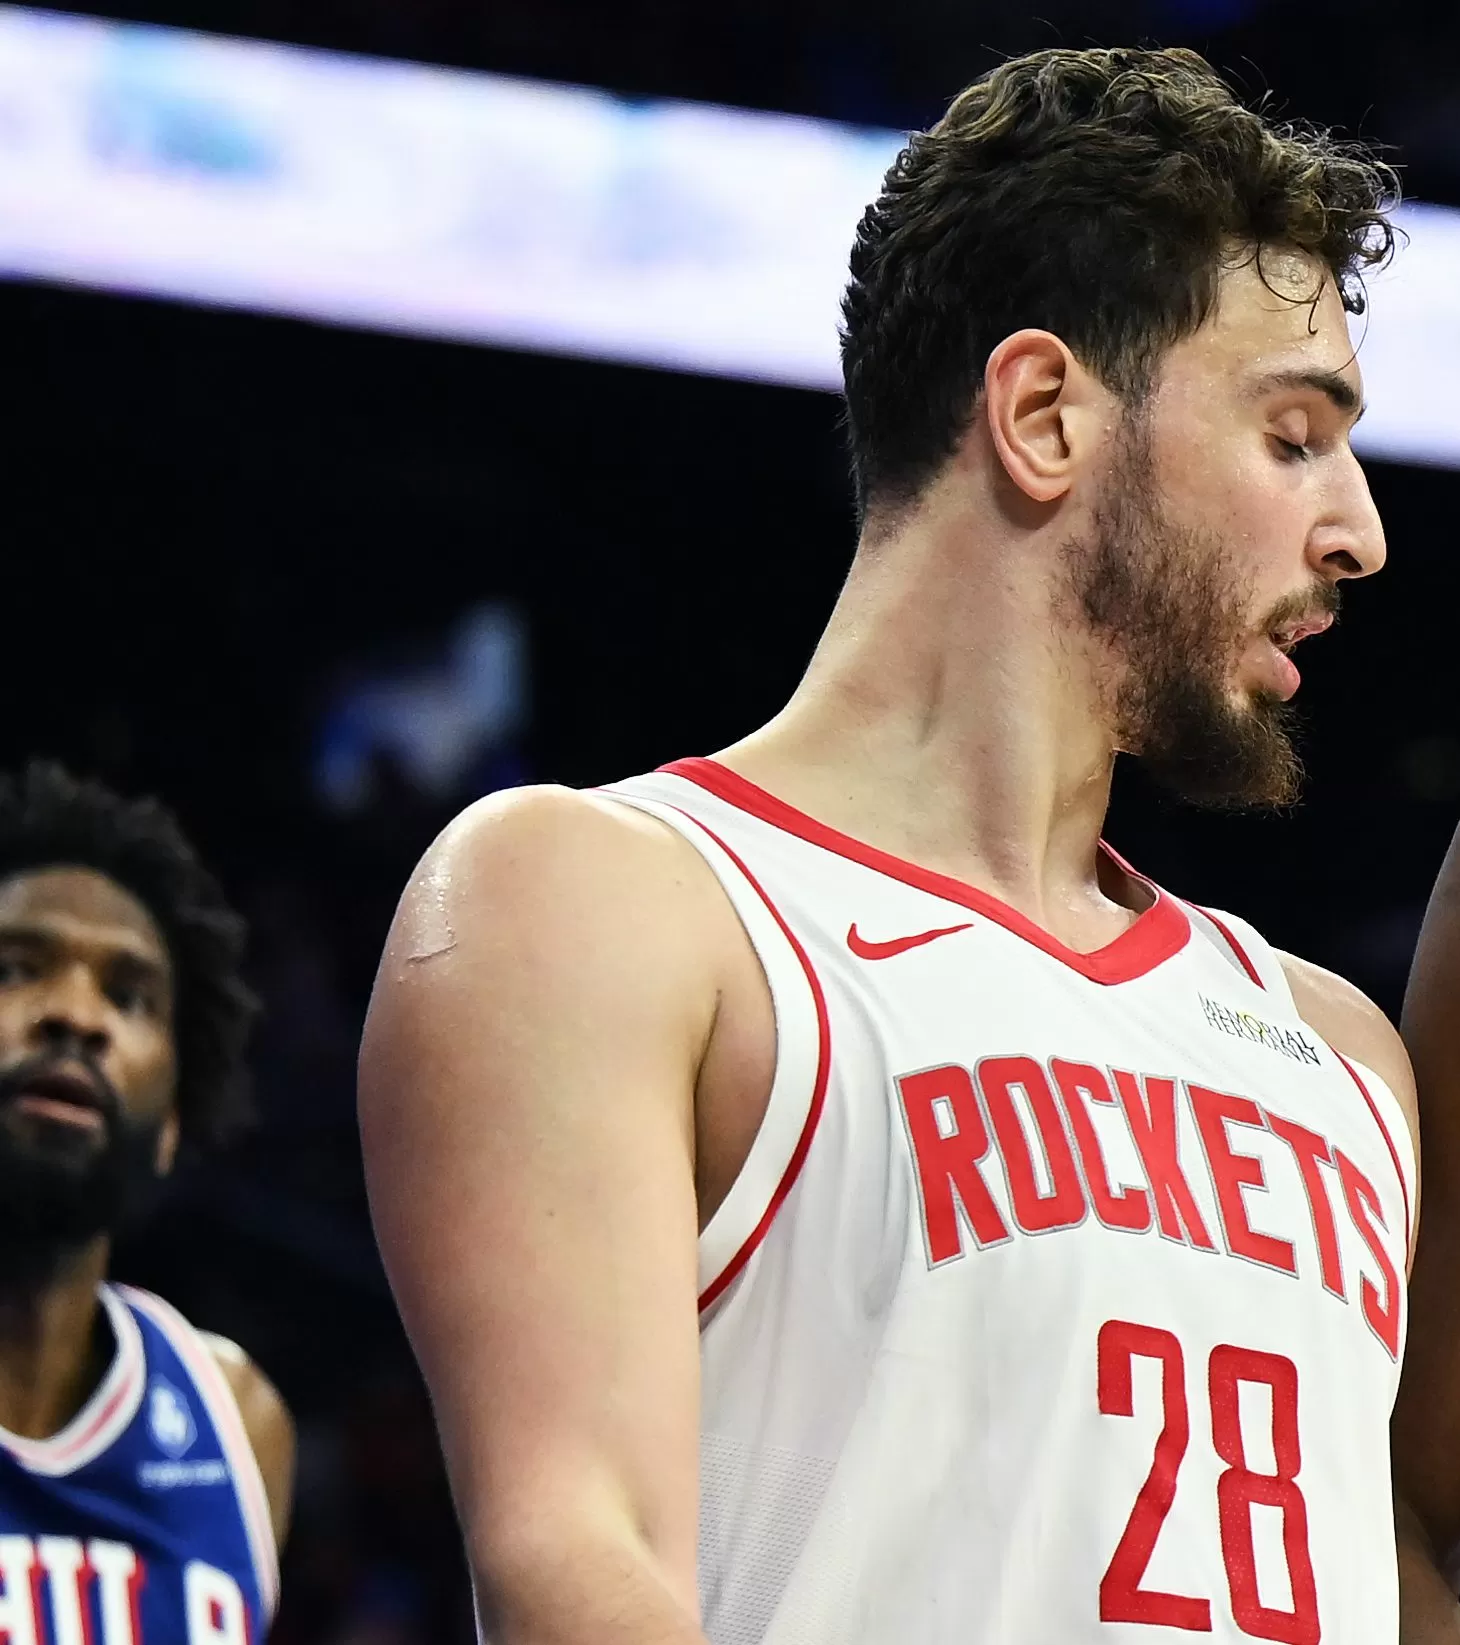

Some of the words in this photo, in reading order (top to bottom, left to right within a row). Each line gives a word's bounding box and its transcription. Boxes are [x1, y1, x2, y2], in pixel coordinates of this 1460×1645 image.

[1198, 992, 1315, 1050] MEMORIAL
[894, 1054, 1398, 1363] ROCKETS
[1098, 1319, 1321, 1645] 28
